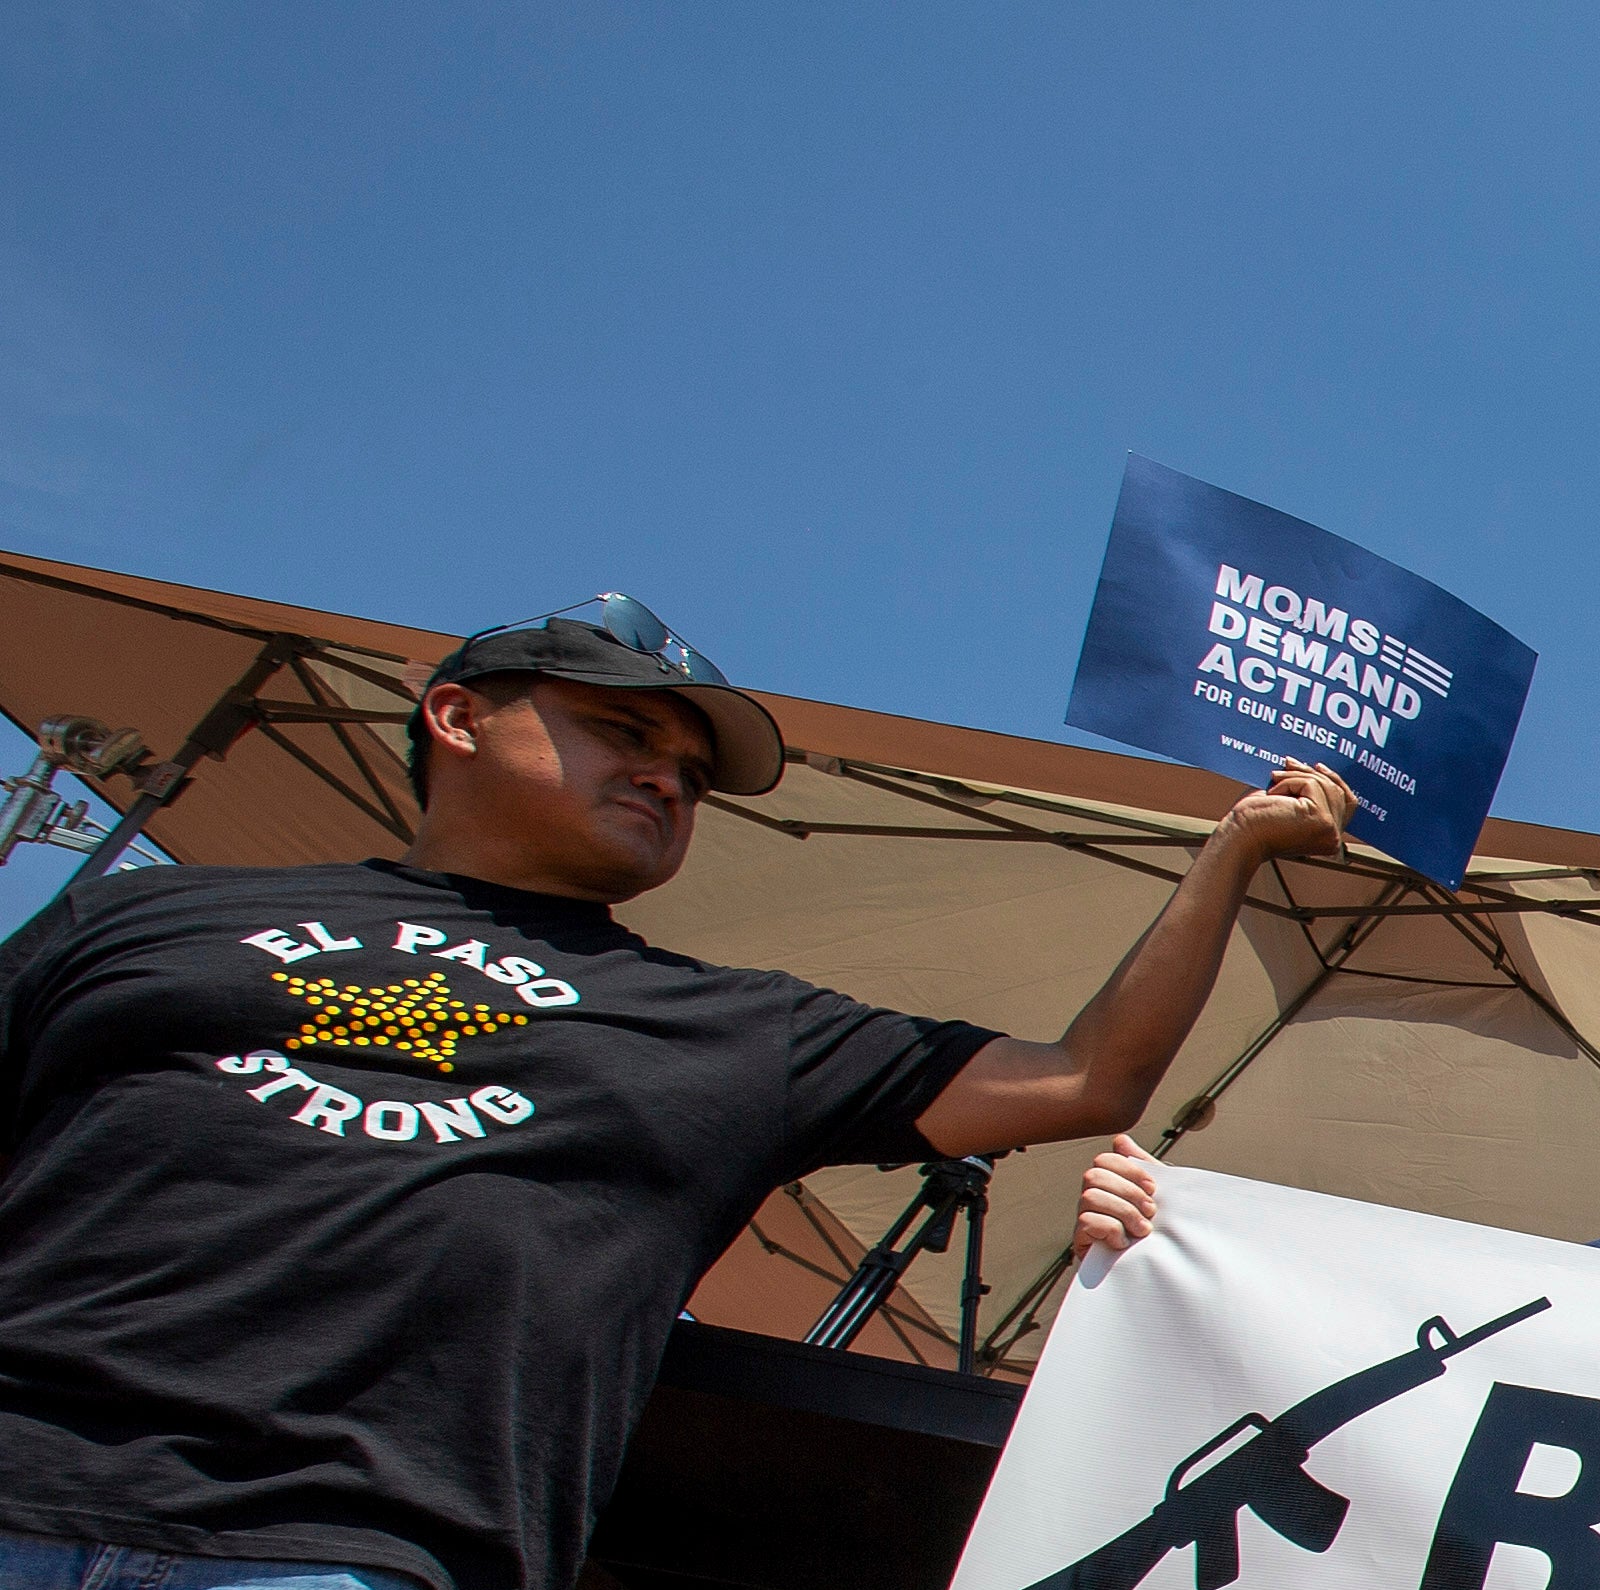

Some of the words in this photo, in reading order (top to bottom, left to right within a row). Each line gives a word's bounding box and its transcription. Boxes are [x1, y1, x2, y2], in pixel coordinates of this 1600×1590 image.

[1215, 563, 1381, 656] MOMS
[1197, 642, 1392, 749] ACTION
[1208, 600, 1422, 720] DEMAND
[1193, 680, 1233, 708] FOR
[1237, 696, 1277, 725] GUN
[1280, 713, 1339, 750] SENSE
[1339, 738, 1357, 760] IN
[1357, 750, 1418, 796] AMERICA
[240, 921, 363, 964] EL
[391, 921, 581, 1008] PASO
[214, 1049, 535, 1143] STRONG
